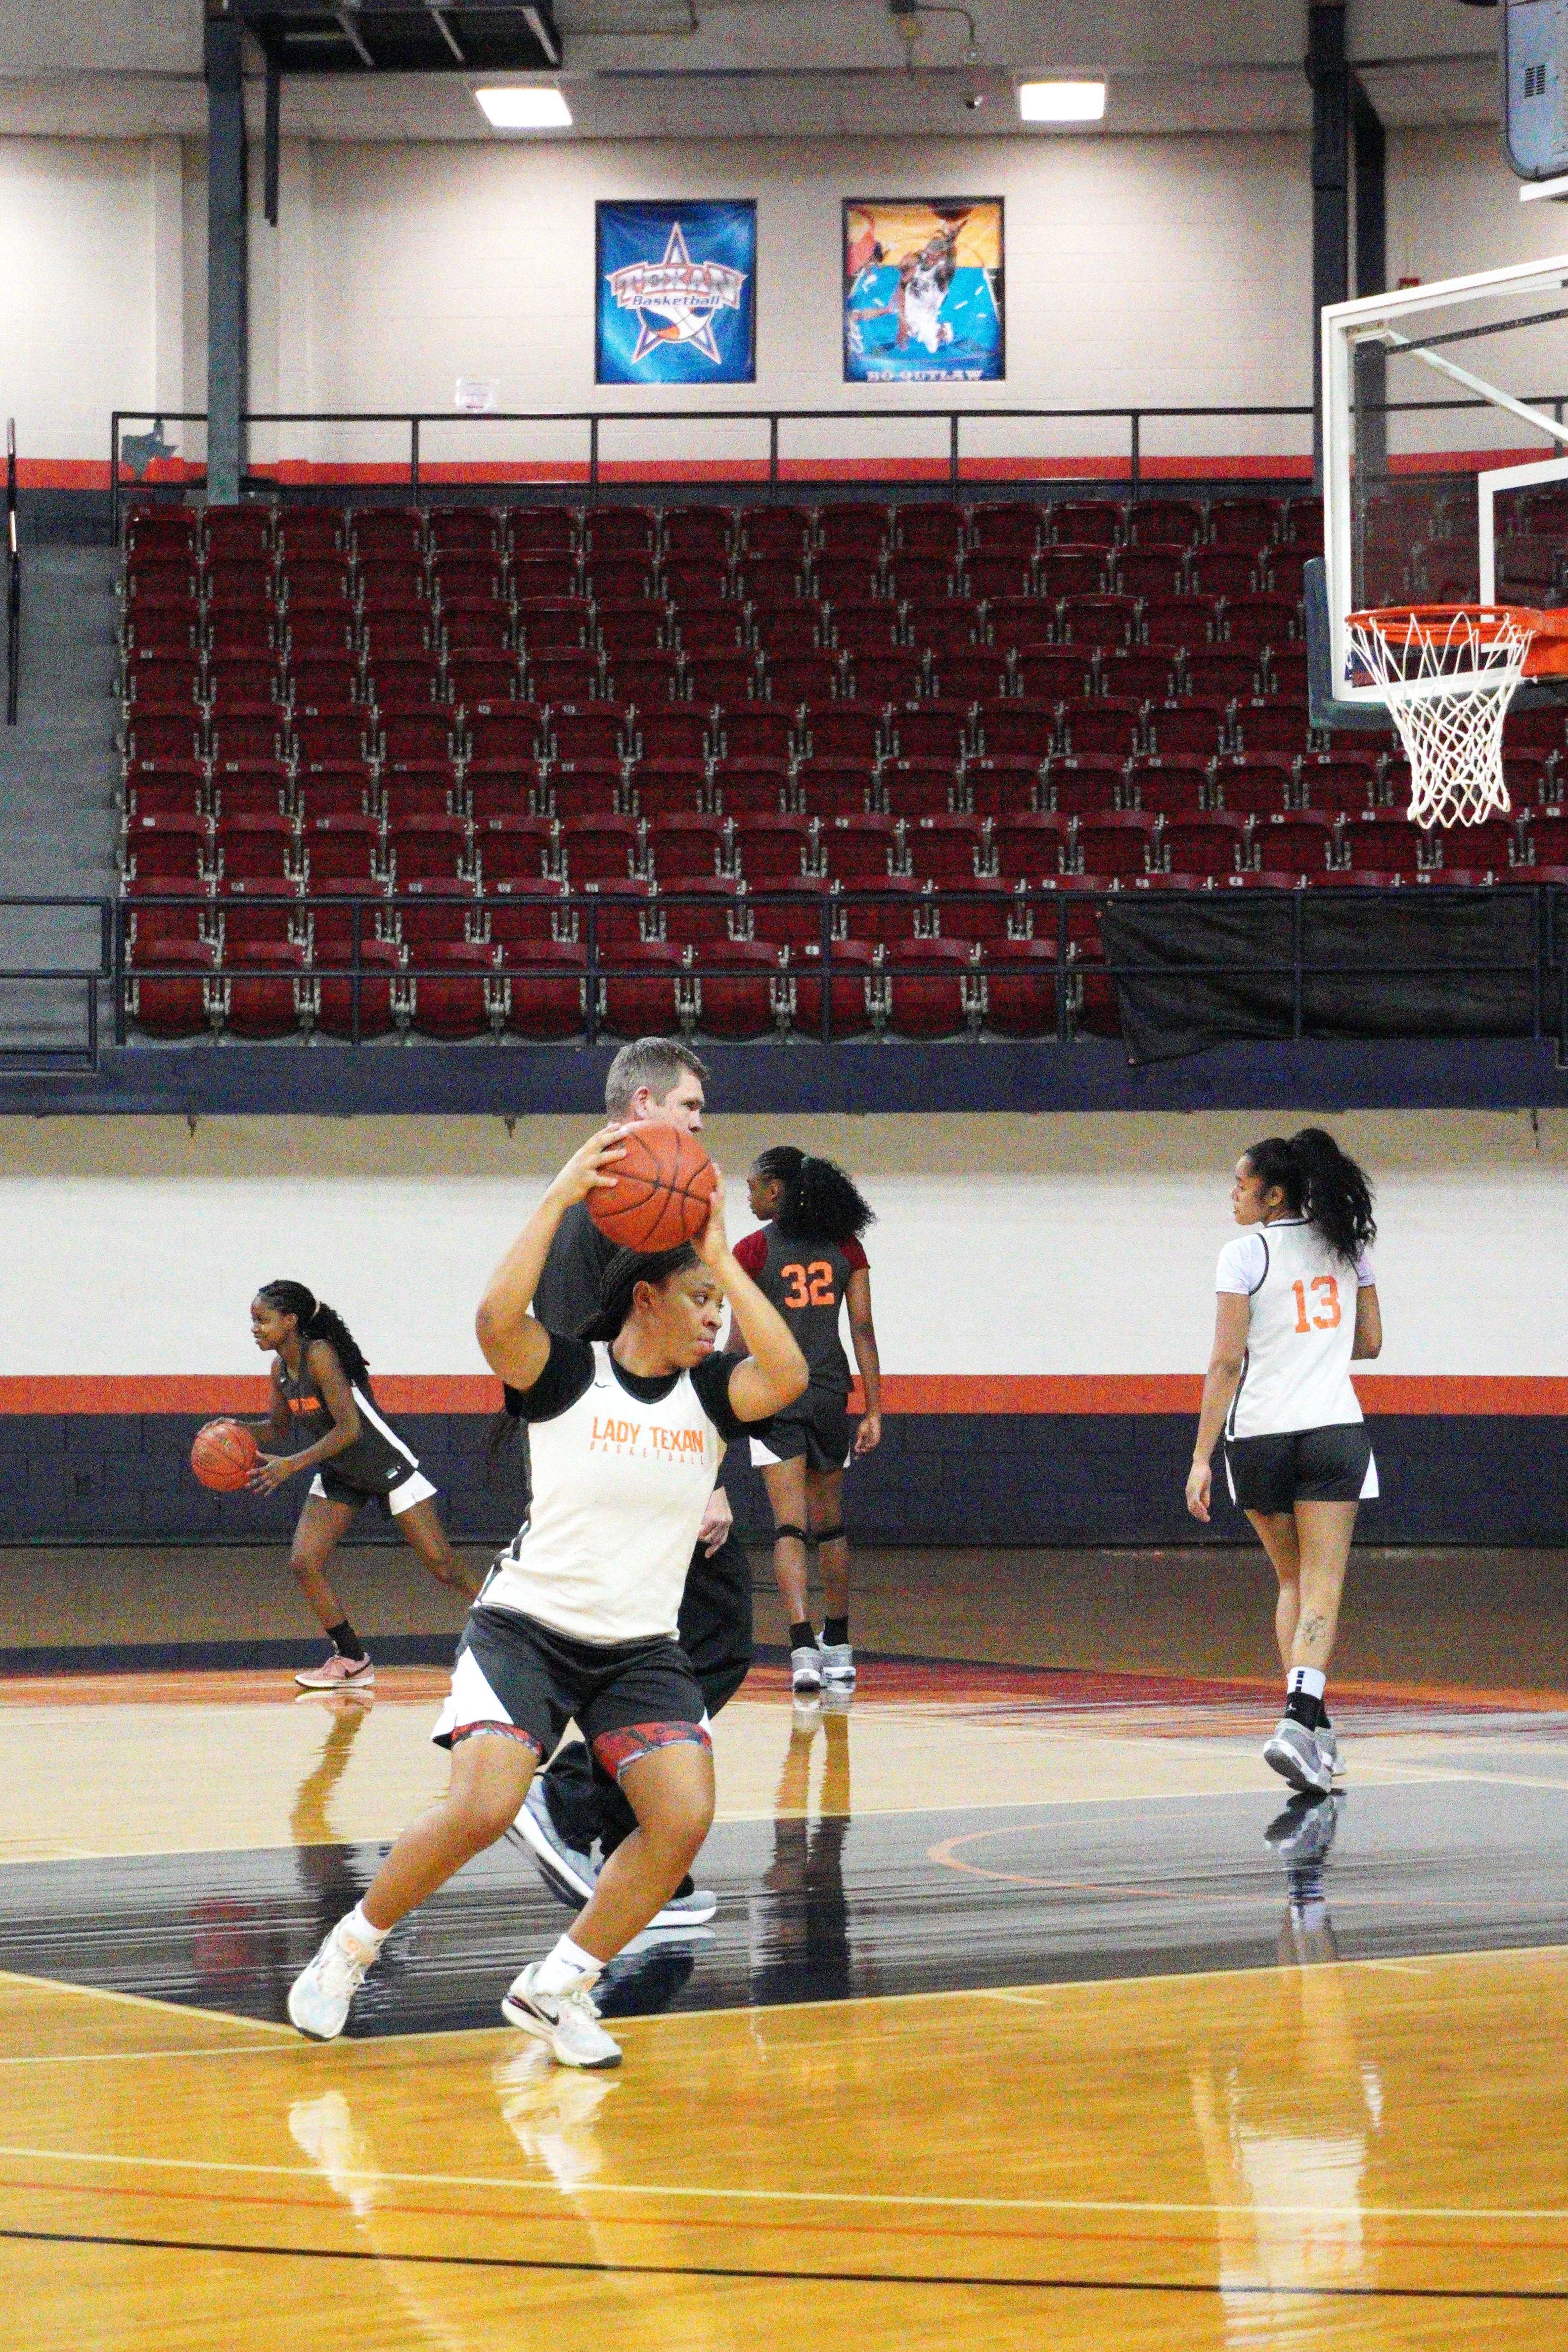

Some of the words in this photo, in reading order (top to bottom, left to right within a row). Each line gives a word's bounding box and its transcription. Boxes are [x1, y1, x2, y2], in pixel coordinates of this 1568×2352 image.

[632, 295, 720, 306] Basketball
[781, 1261, 835, 1309] 32
[1291, 1275, 1341, 1334] 13
[589, 1440, 705, 1465] BASKETBALL
[592, 1416, 641, 1445] LADY
[649, 1426, 704, 1453] TEXAN
